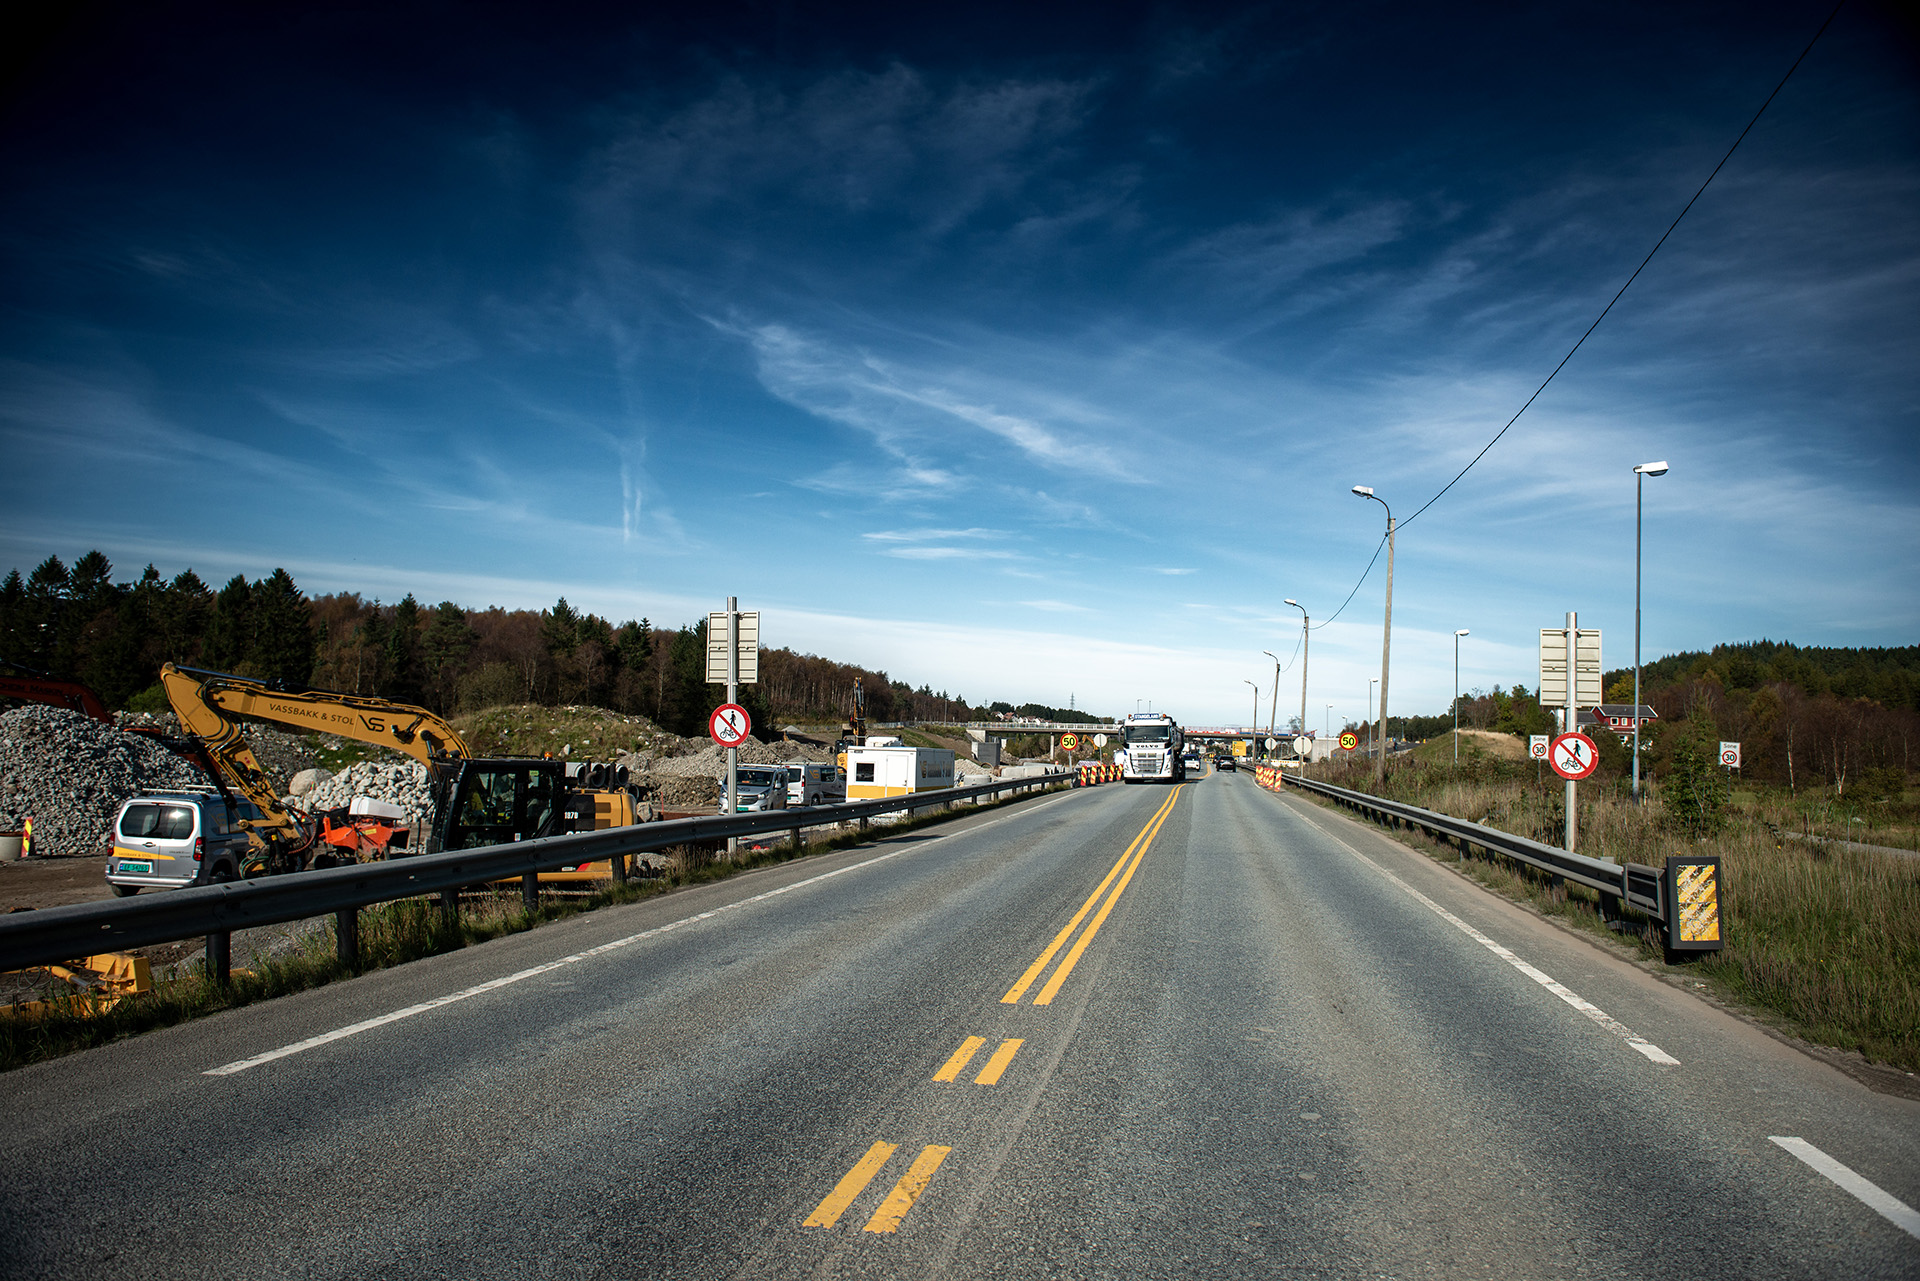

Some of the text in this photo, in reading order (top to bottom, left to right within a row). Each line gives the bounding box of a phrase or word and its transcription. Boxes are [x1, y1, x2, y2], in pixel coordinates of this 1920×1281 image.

[269, 703, 318, 718] VASSBAKK
[331, 714, 354, 725] STOL
[1063, 737, 1075, 746] 50
[1342, 736, 1355, 746] 50
